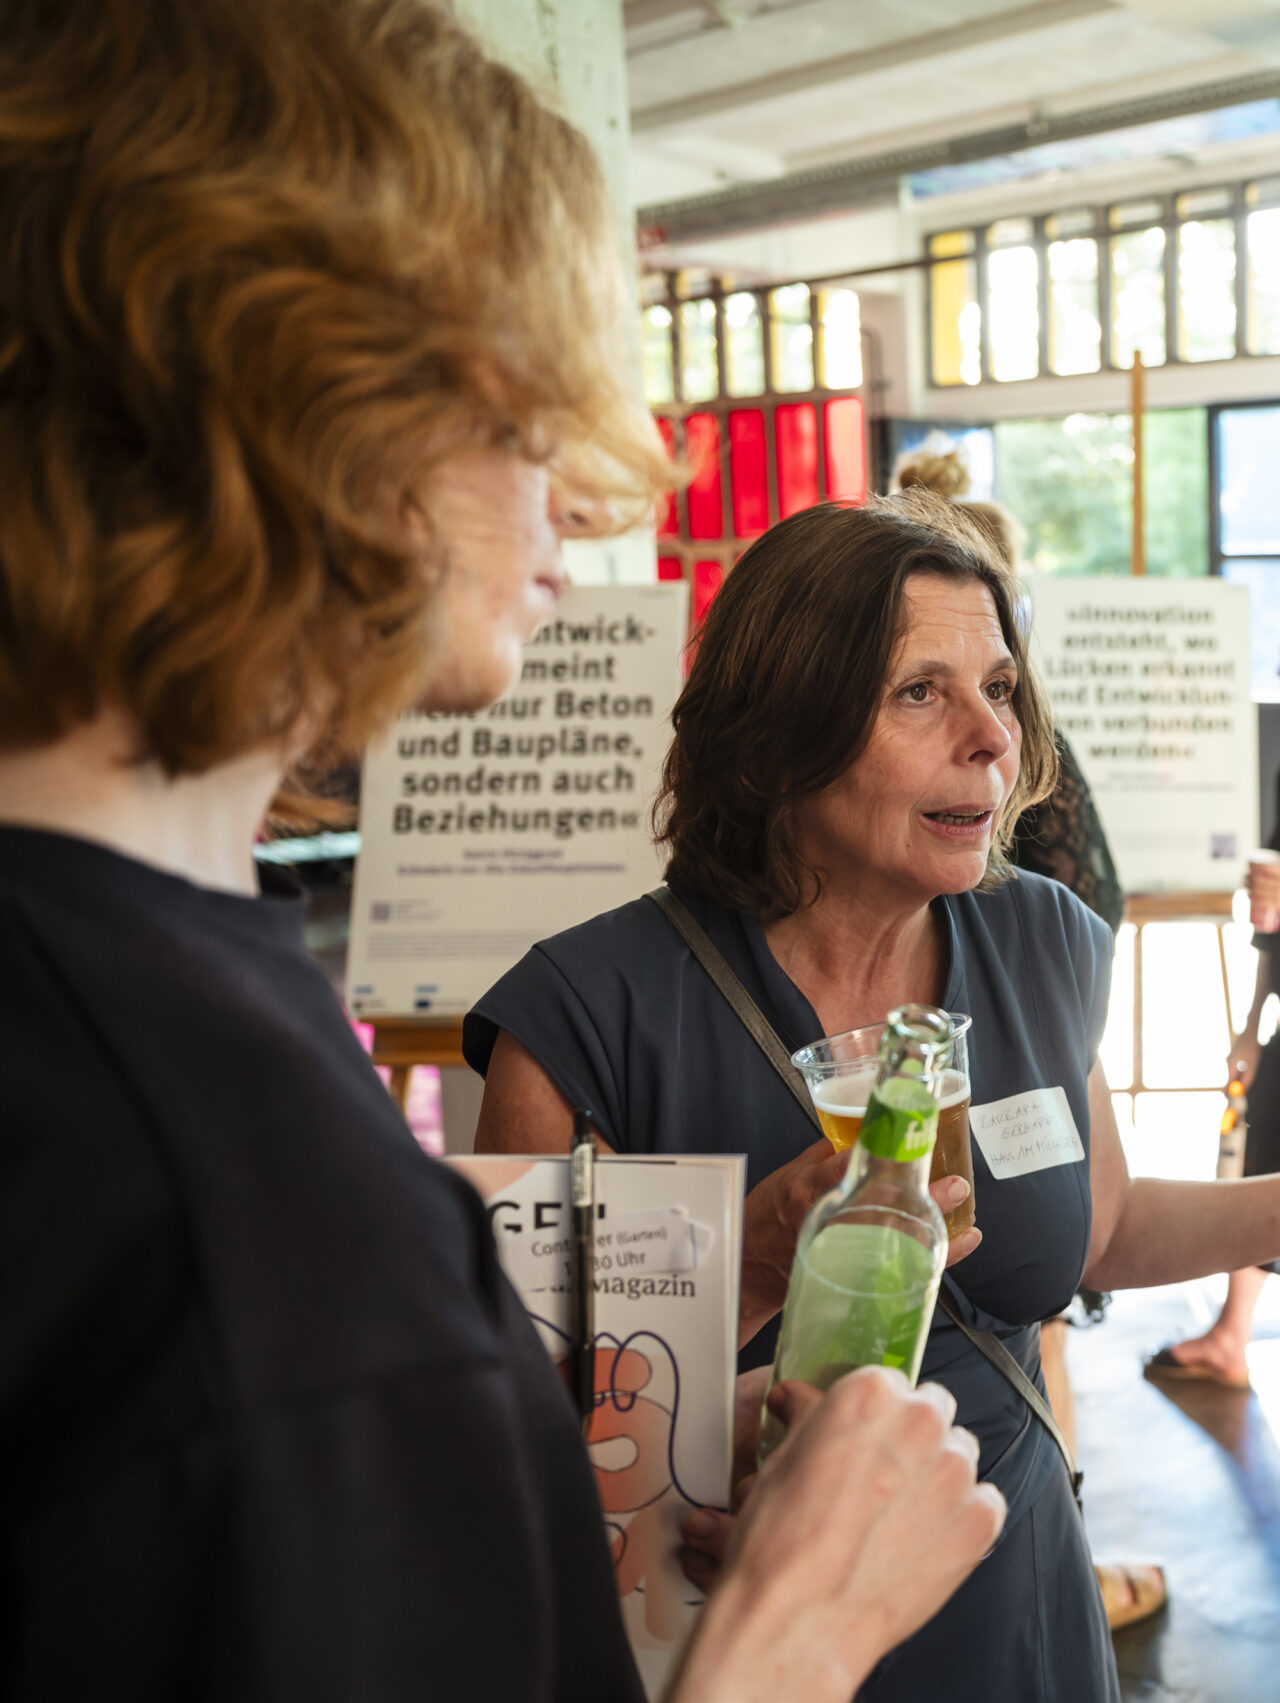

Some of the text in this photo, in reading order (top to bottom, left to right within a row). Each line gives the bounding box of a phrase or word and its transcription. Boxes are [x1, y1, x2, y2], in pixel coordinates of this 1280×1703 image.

[554, 691, 653, 719] Beton
[398, 728, 643, 763] und Baupläne,
[402, 767, 634, 795] sondern auch
[617, 1251, 645, 1267] Uhr
